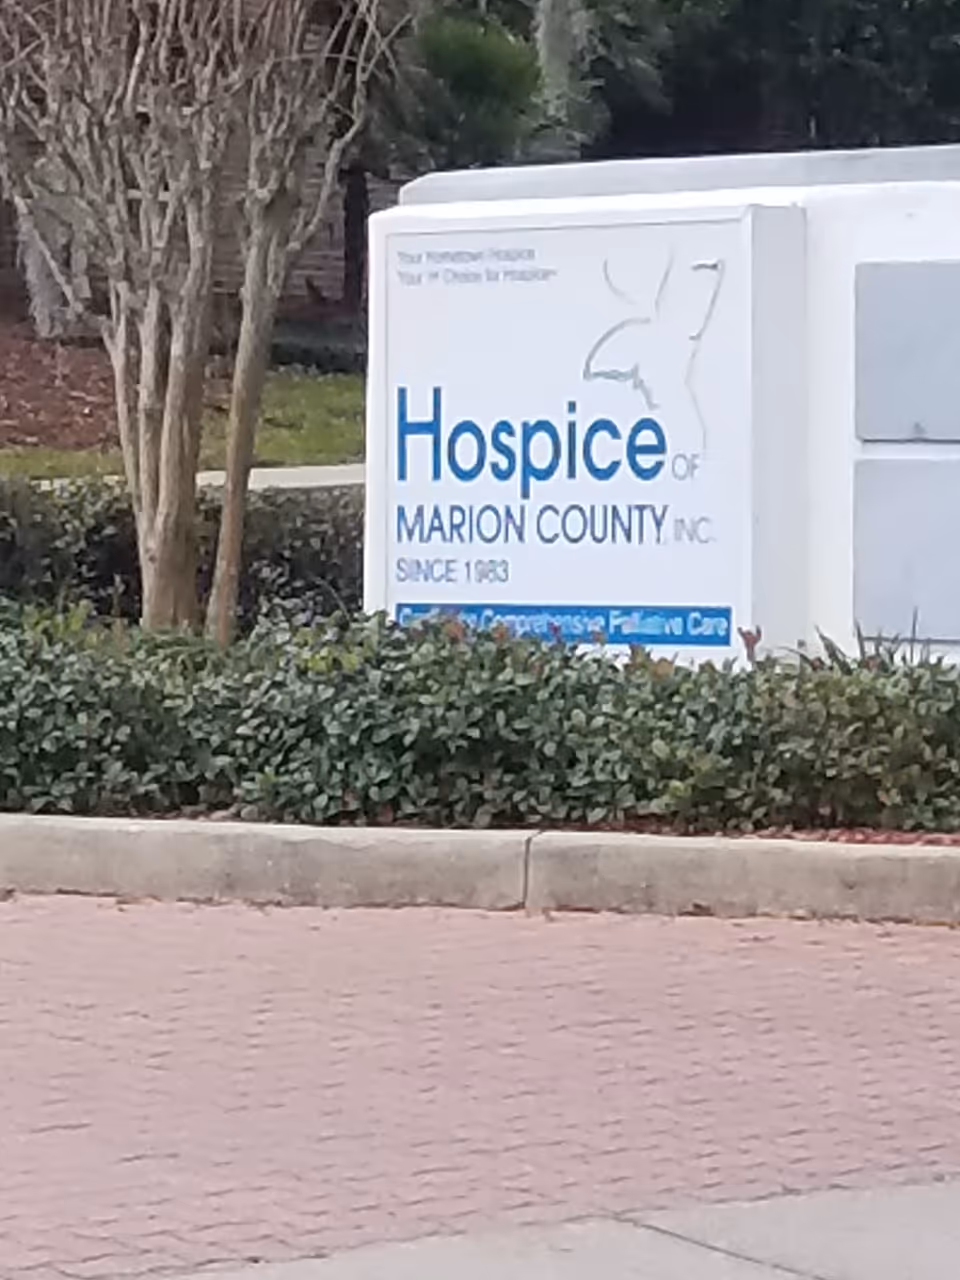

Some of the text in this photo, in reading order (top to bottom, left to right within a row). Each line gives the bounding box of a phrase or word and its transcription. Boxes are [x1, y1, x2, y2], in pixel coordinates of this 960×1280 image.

[397, 387, 699, 499] Hospice OF
[396, 504, 525, 543] MARION
[396, 558, 509, 582] SINCE 1983
[686, 611, 727, 636] Care
